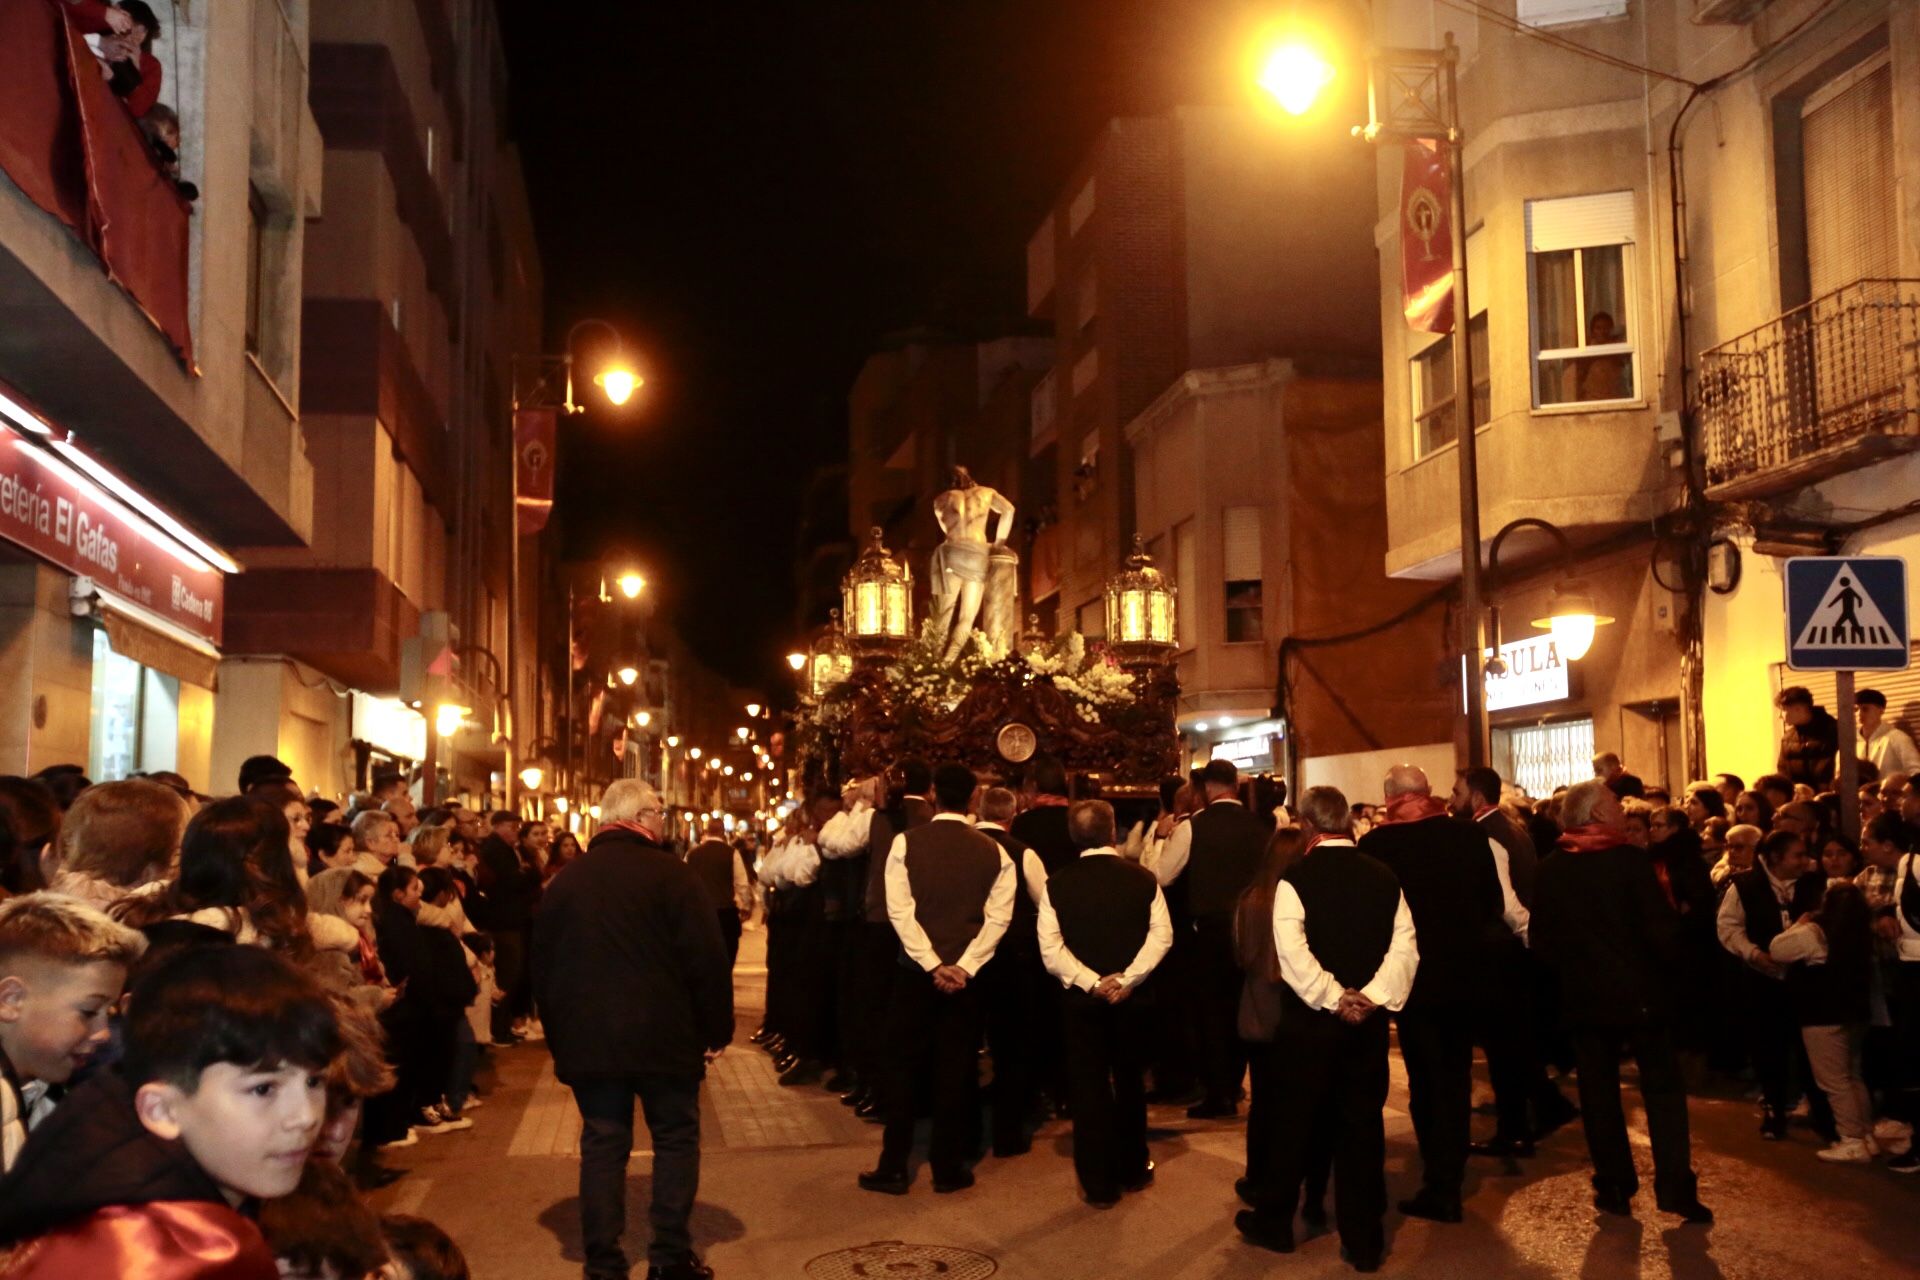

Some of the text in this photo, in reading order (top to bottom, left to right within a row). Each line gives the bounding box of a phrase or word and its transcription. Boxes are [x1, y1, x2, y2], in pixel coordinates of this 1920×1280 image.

[0, 473, 118, 573] etería El Gafas
